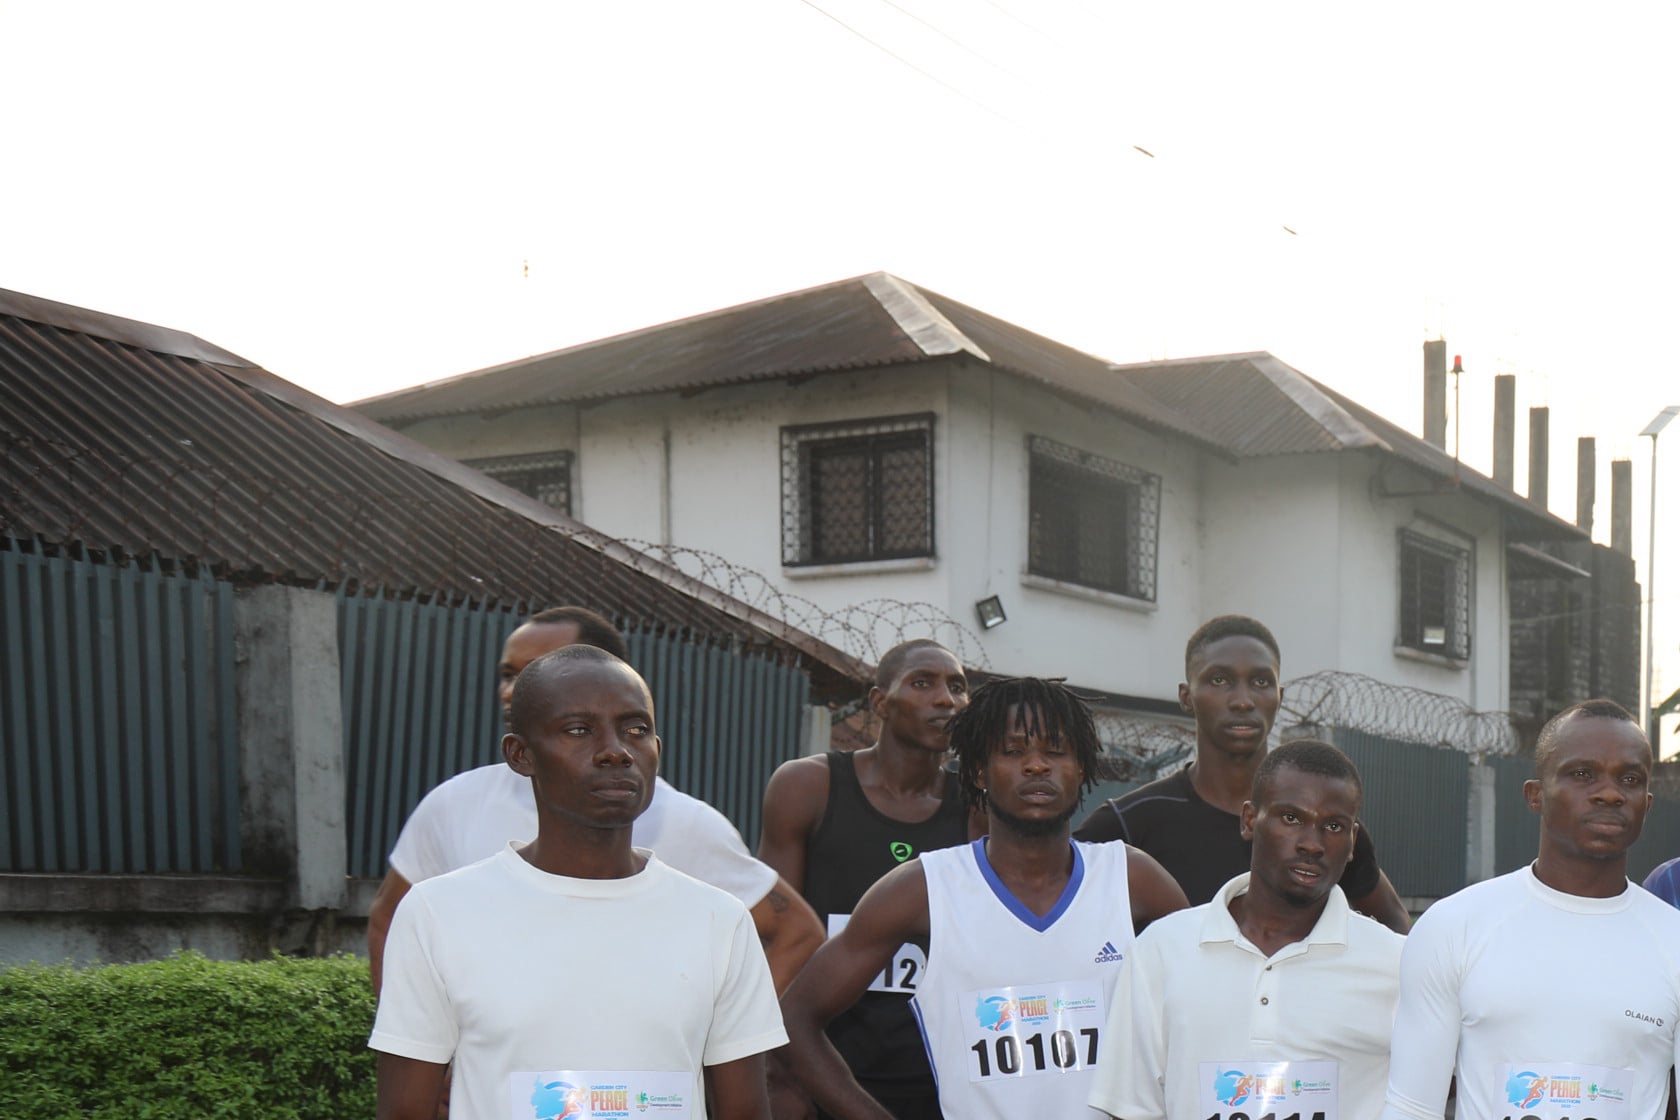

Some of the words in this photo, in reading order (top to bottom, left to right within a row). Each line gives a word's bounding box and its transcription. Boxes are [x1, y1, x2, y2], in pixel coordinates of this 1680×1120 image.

[1094, 952, 1123, 964] adidas
[1019, 999, 1049, 1018] PEACE
[1625, 1009, 1656, 1024] OLAIAN
[971, 1028, 1099, 1077] 10107
[590, 1090, 629, 1111] PEACE
